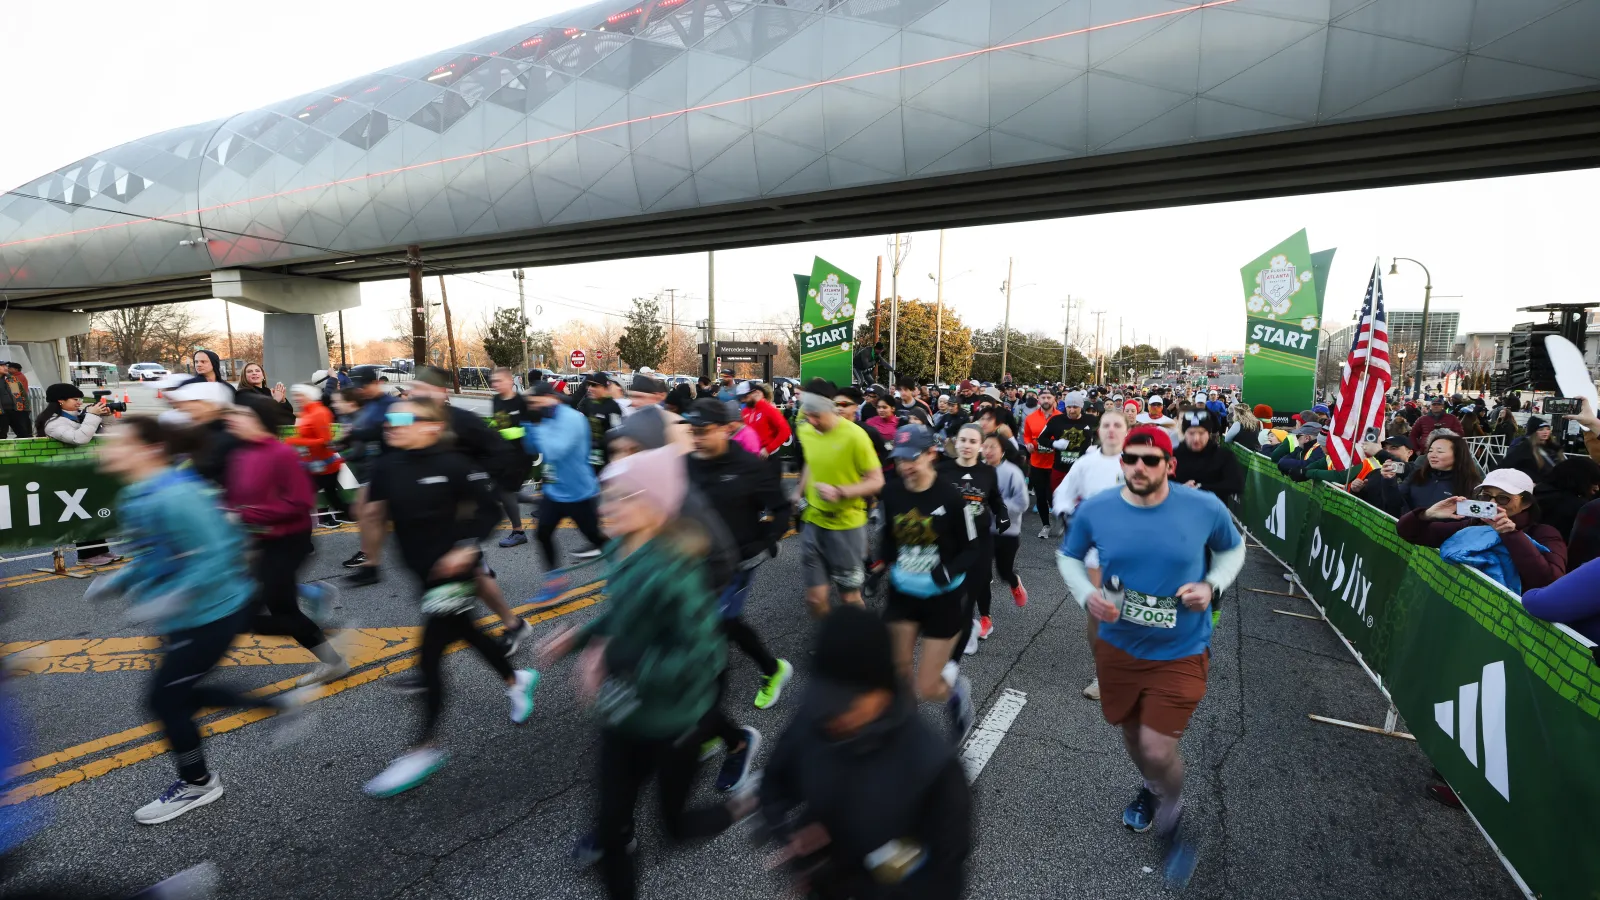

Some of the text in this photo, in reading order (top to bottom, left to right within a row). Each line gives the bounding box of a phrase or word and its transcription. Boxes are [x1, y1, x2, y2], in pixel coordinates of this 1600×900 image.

[805, 326, 847, 348] START
[1251, 324, 1313, 350] START
[1125, 604, 1174, 623] E7004
